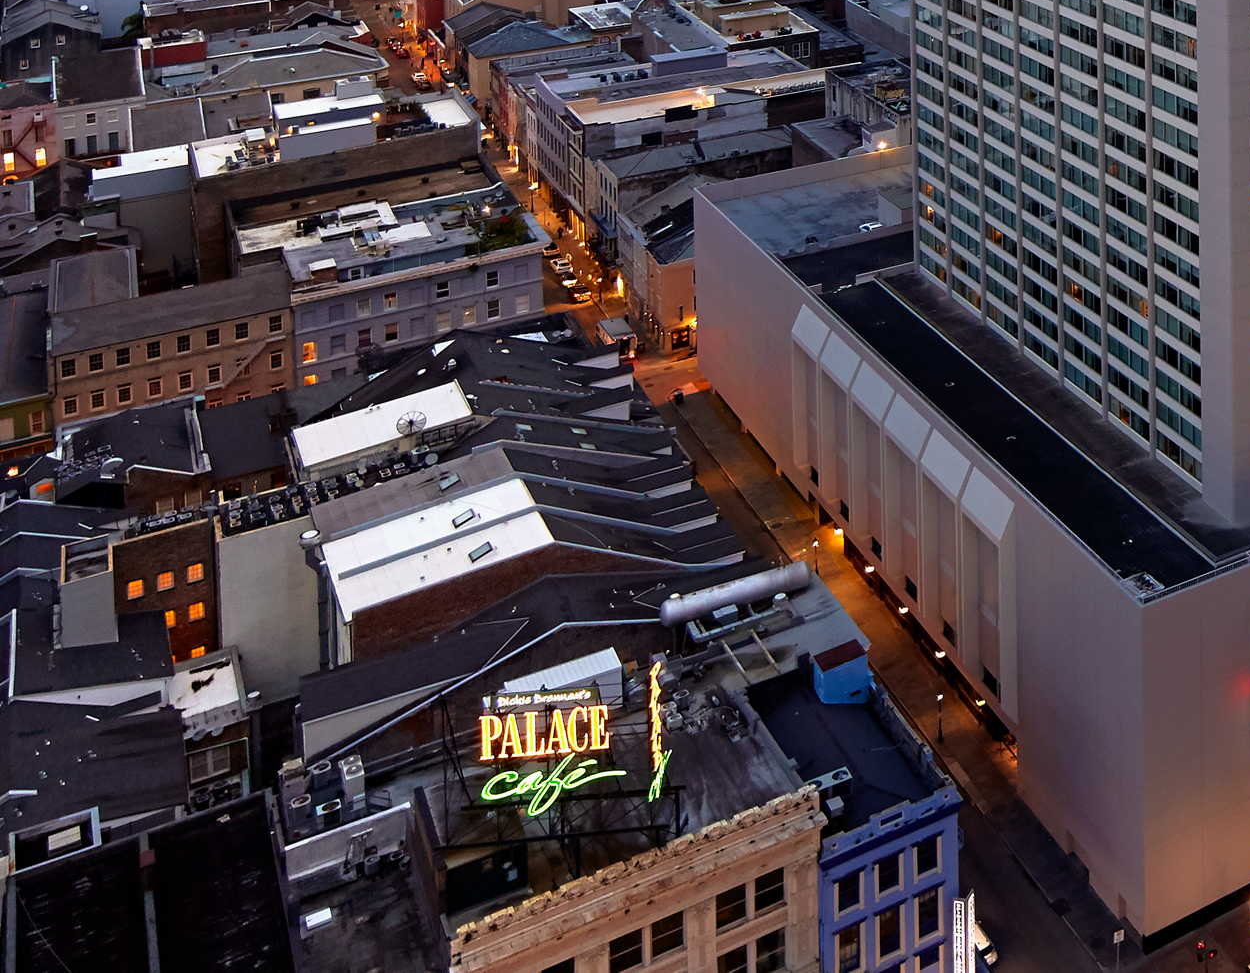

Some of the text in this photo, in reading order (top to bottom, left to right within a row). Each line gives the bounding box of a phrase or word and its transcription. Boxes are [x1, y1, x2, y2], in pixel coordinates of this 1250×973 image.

[497, 689, 592, 708] Dickie Brennan's
[479, 705, 610, 761] PALACE
[480, 752, 627, 817] café
